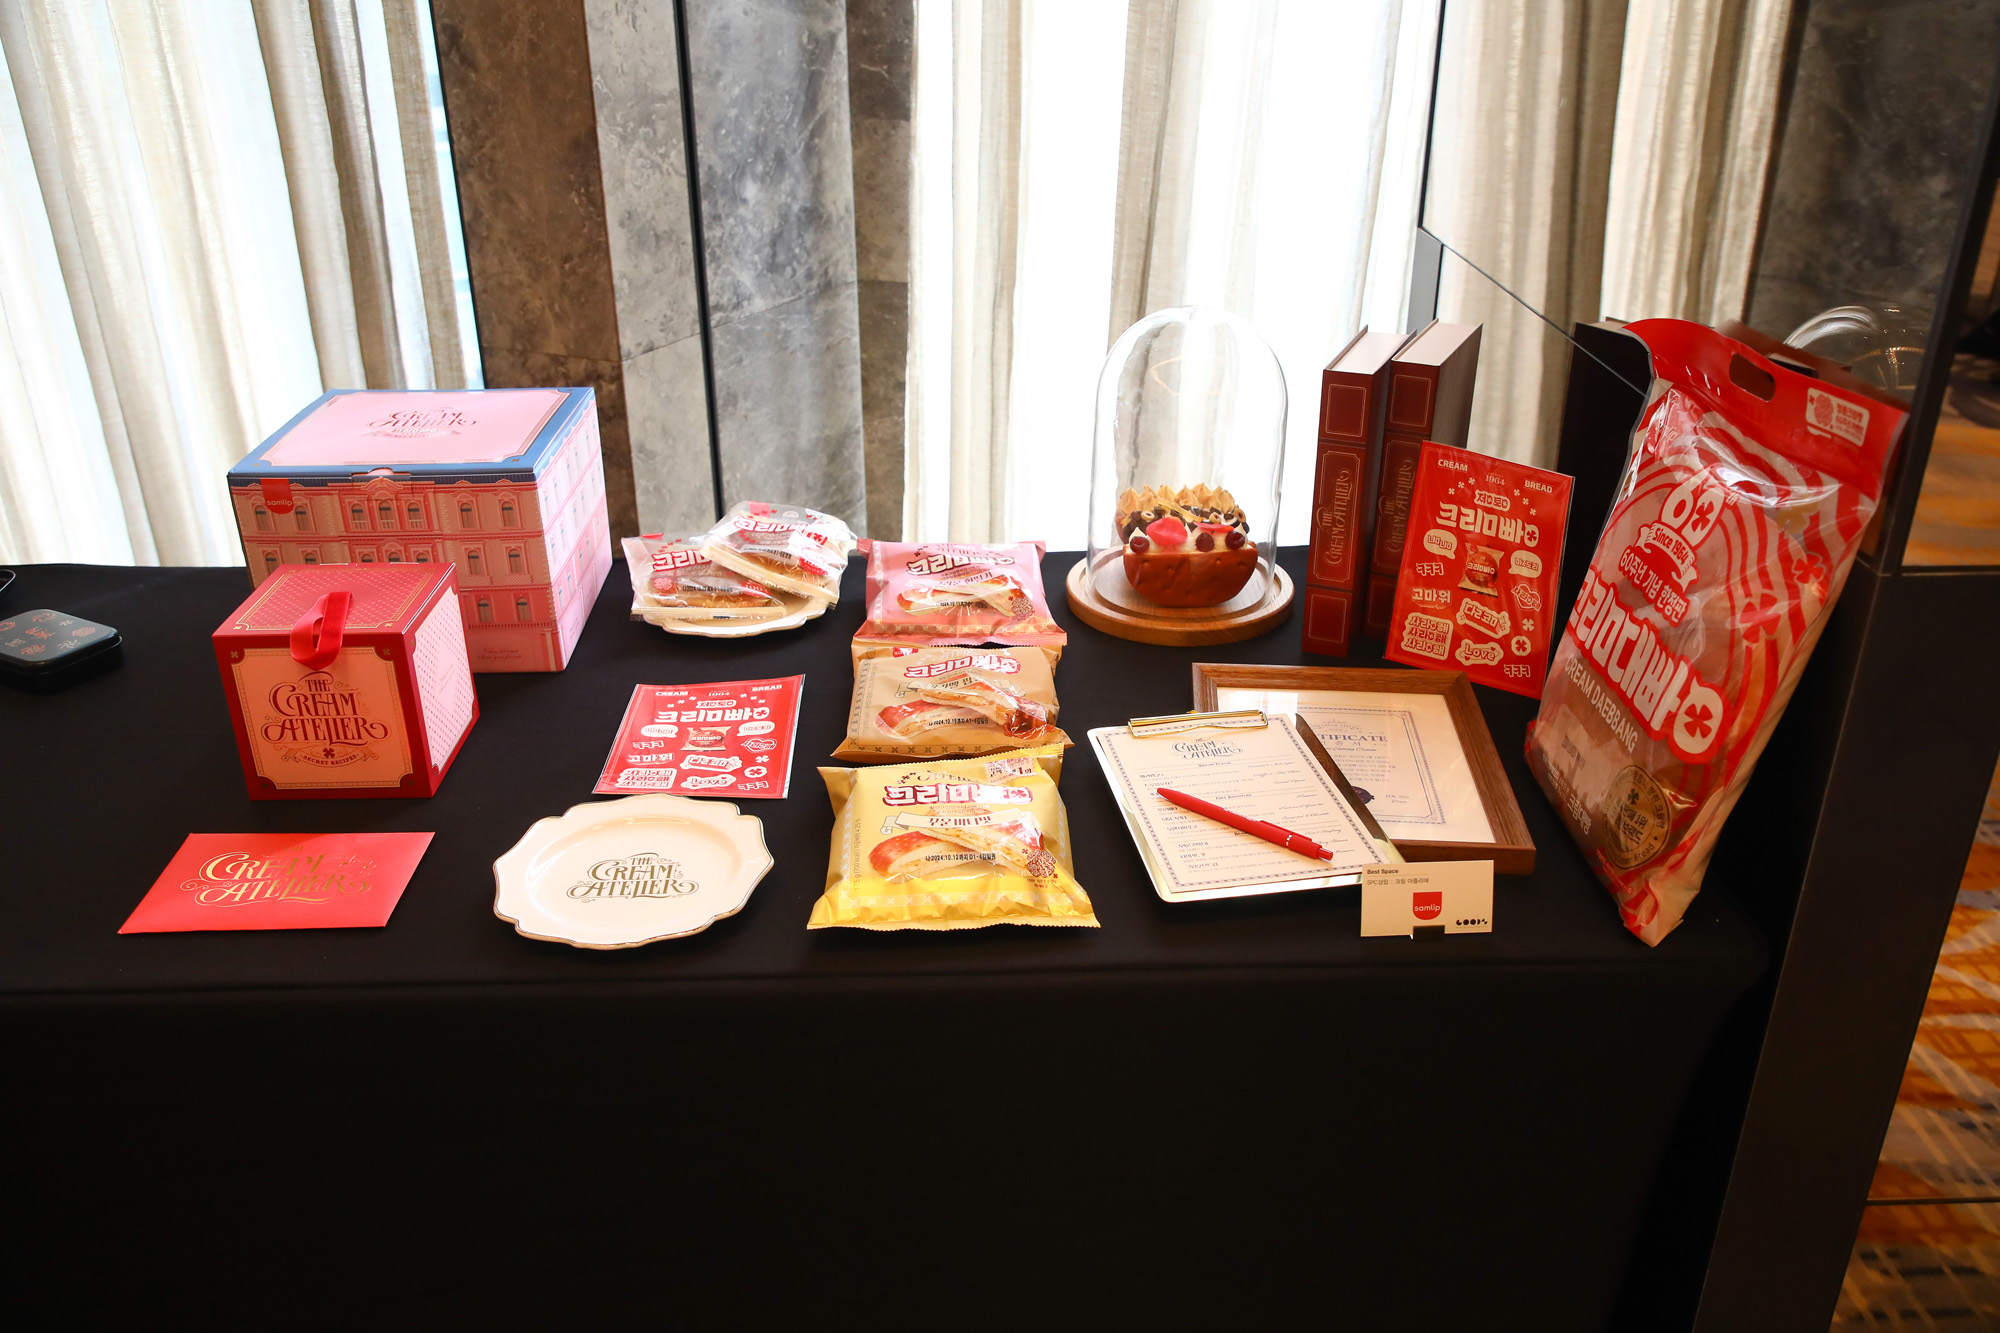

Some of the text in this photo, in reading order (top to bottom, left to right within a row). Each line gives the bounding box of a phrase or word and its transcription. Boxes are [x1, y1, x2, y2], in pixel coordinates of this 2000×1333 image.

[1437, 458, 1469, 472] CREAM
[1485, 474, 1506, 487] 1964
[1524, 479, 1553, 494] BREAD
[1652, 527, 1691, 566] Since 1964
[1620, 548, 1688, 623] 60주년 기념 한정판
[1411, 588, 1451, 604] 고마워
[1464, 643, 1496, 661] Love
[752, 684, 783, 692] BREAD
[269, 681, 358, 717] CREAM
[1565, 655, 1596, 698] CREAM
[1591, 687, 1639, 754] DAEBBANG
[261, 717, 389, 747] ATELIER
[1172, 741, 1216, 753] CREAM
[1183, 747, 1244, 760] ATELIER
[303, 753, 358, 765] SECRET RECIPES
[629, 753, 674, 763] 고마워
[691, 777, 728, 786] Love
[1634, 843, 1655, 862] Bread
[199, 851, 324, 882] CREAM
[587, 860, 675, 882] CREAM
[194, 874, 370, 905] ATELIER
[566, 879, 699, 899] ATELIER
[1414, 904, 1441, 912] samlip
